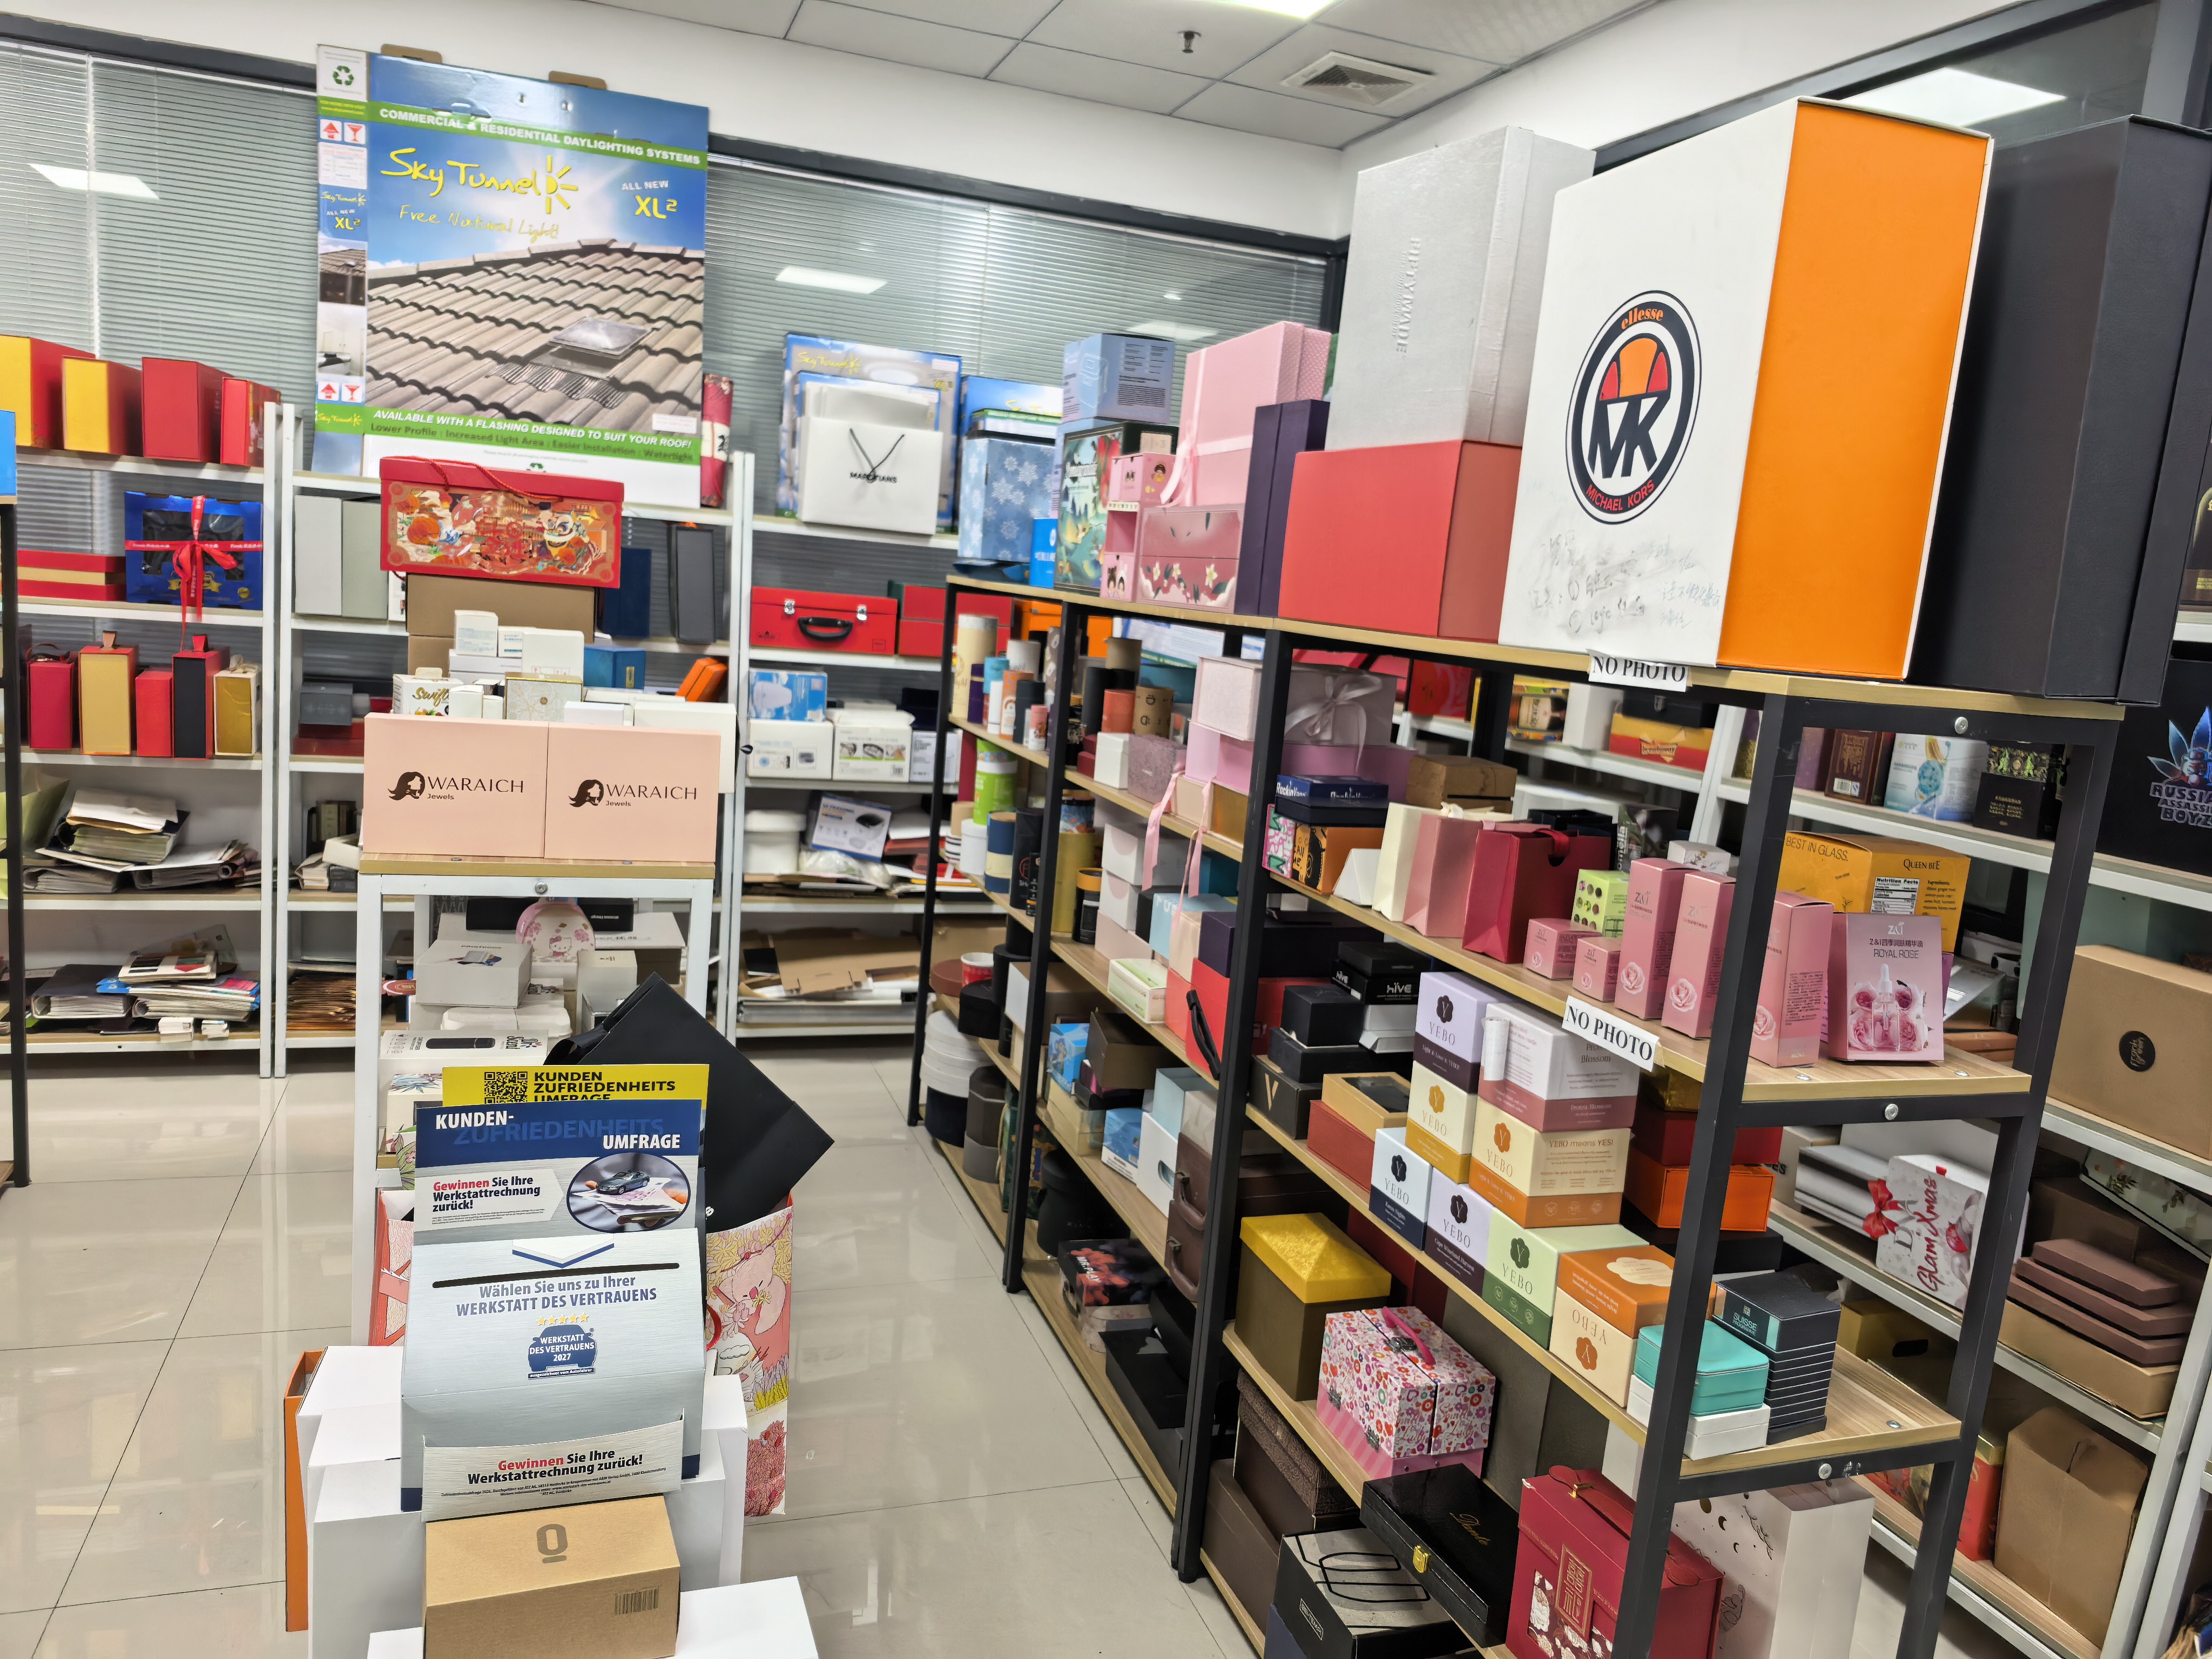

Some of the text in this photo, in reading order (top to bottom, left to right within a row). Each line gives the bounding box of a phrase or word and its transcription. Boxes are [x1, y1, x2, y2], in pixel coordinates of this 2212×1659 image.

[380, 109, 464, 129] COMMERCIAL
[467, 119, 476, 130] &
[481, 123, 561, 143] RESIDENTIAL
[563, 136, 644, 156] DAYLIGHTING
[646, 148, 700, 164] SYSTEMS
[380, 147, 443, 197] Sky
[446, 160, 542, 195] Tunnel
[622, 180, 669, 191] ALL NEW
[400, 204, 441, 224] Free
[448, 211, 513, 233] Natural
[1621, 308, 1663, 330] ellesse
[373, 410, 692, 448] AVAILABLE WITH A FLASHING DESIGNED TO SUIT YOUR ROOF!
[370, 423, 693, 461] Lower Profile Increased Light Area Easier Installation Watertight
[1586, 480, 1655, 511] MICHAEL KORS
[1593, 656, 1686, 683] NO PHOTO
[427, 776, 523, 793] WARAICH
[606, 784, 697, 800] WARAICH
[1786, 837, 1849, 862] BEST IN GLASS
[1873, 948, 1919, 959] ROYAL ROSE
[1429, 1021, 1456, 1046] YEBO
[1566, 1005, 1653, 1061] NO PHOTO
[1581, 1054, 1611, 1063] Blossom
[534, 1071, 602, 1082] KUNDEN
[534, 1081, 676, 1093] ZUFRIEDENHEITS
[534, 1094, 611, 1102] UMFRAGE
[436, 1110, 514, 1130] KUNDEN-
[1422, 1110, 1447, 1136] YEBO
[454, 1118, 664, 1145] ZUFRIEDENHEITS
[603, 1134, 680, 1149] UMFRAGE
[1549, 1139, 1568, 1148] YEBO
[1487, 1148, 1513, 1177] YEBO
[433, 1176, 533, 1191] Gewinnen Sie Ihre
[433, 1186, 541, 1202] Werkstattrechnung
[1385, 1178, 1409, 1205] YEBO
[433, 1199, 473, 1212] zurück!
[1444, 1218, 1471, 1248] YEBO
[1913, 1175, 1946, 1292] Glam Xmas
[480, 1276, 636, 1298] Wählen Sie uns zu Ihrer
[1503, 1263, 1533, 1295] YEBO
[456, 1287, 657, 1317] WERKSTATT DES VERTRAUENS
[1572, 1309, 1607, 1345] YEBO
[1733, 1312, 1757, 1331] SUISSE
[529, 1341, 595, 1355] DES VERTRAUENS
[540, 1334, 584, 1345] WERKSTATT
[553, 1353, 571, 1362] 2027
[468, 1465, 594, 1485] Werkstattrechnung
[597, 1454, 643, 1472] zurück!
[498, 1449, 615, 1471] Gewinnen Sie Ihre
